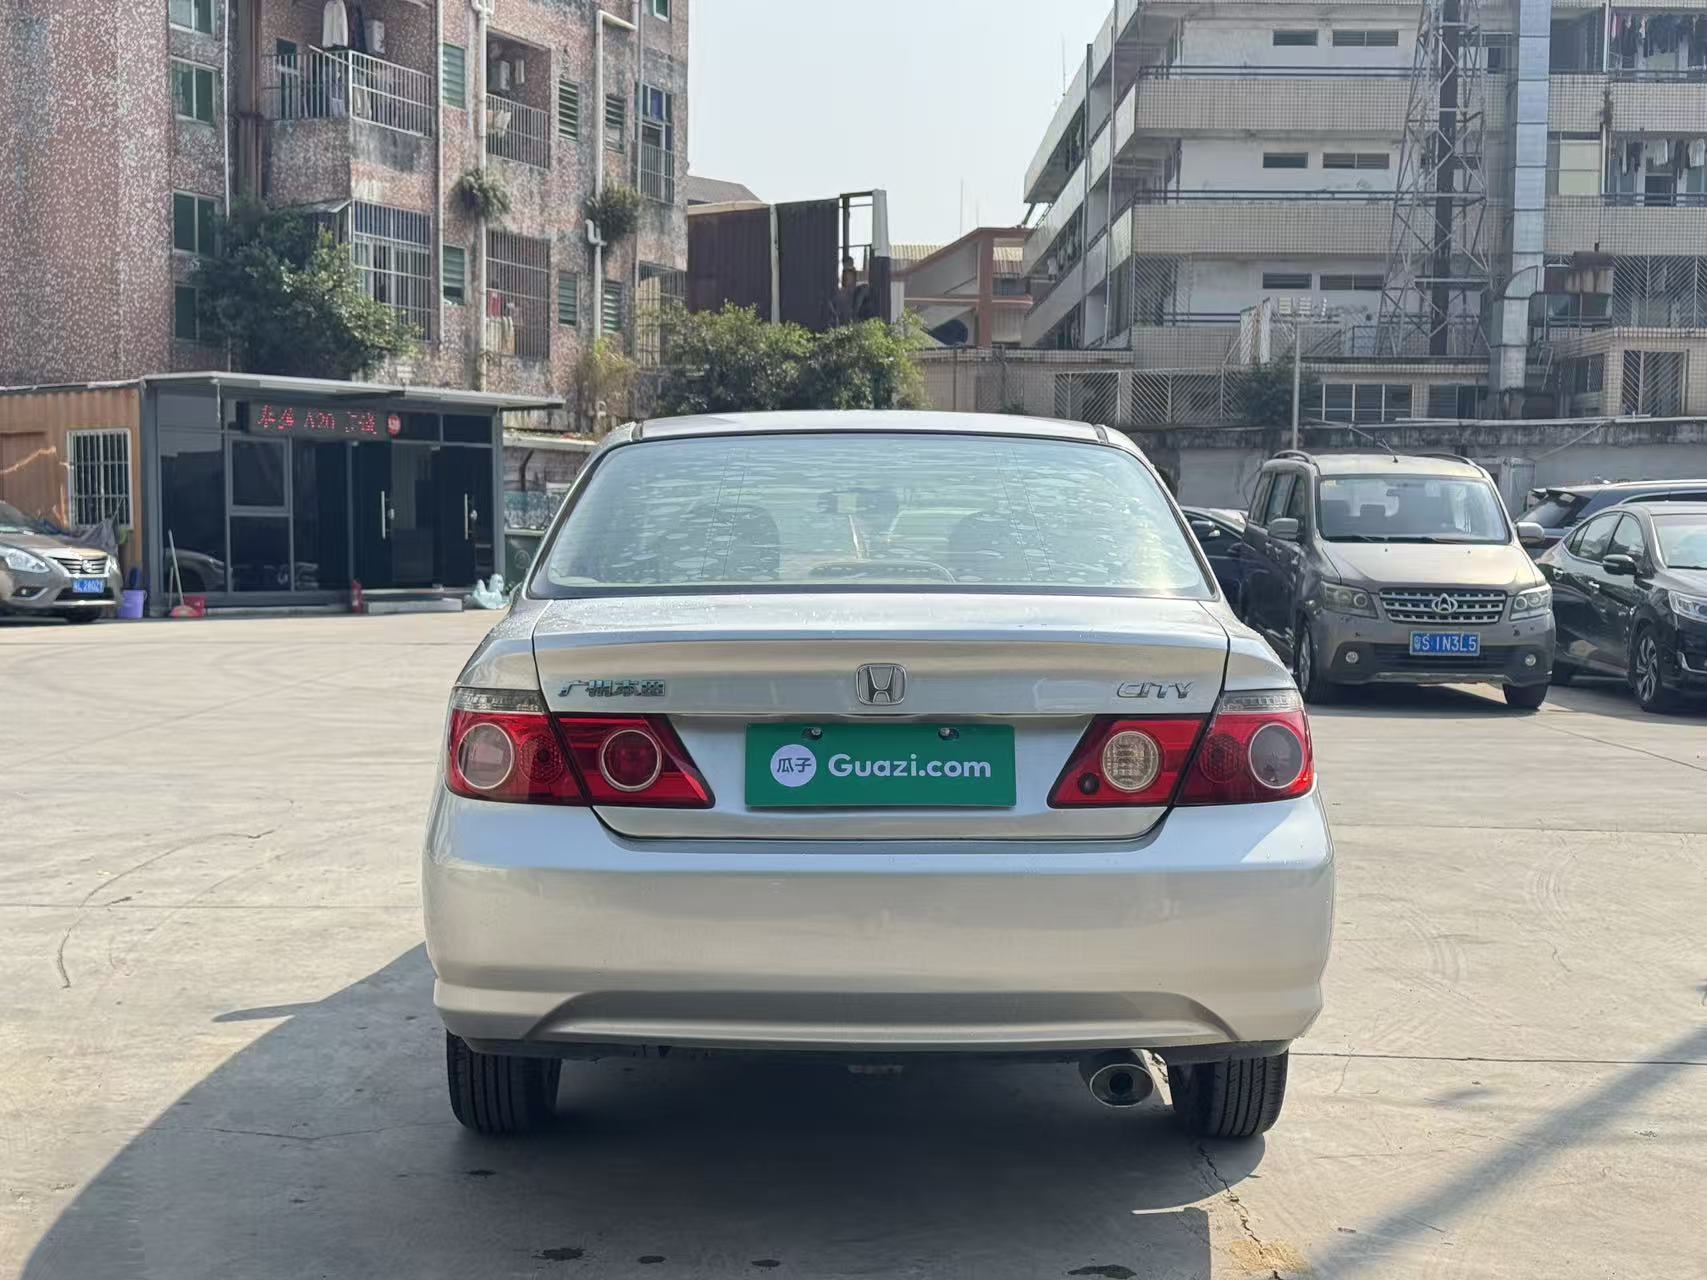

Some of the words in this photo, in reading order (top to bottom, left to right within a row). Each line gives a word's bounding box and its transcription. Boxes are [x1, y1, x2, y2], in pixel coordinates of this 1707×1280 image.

[1116, 681, 1194, 699] CITY
[776, 756, 812, 774] 瓜子
[827, 753, 992, 778] Guazi.com
